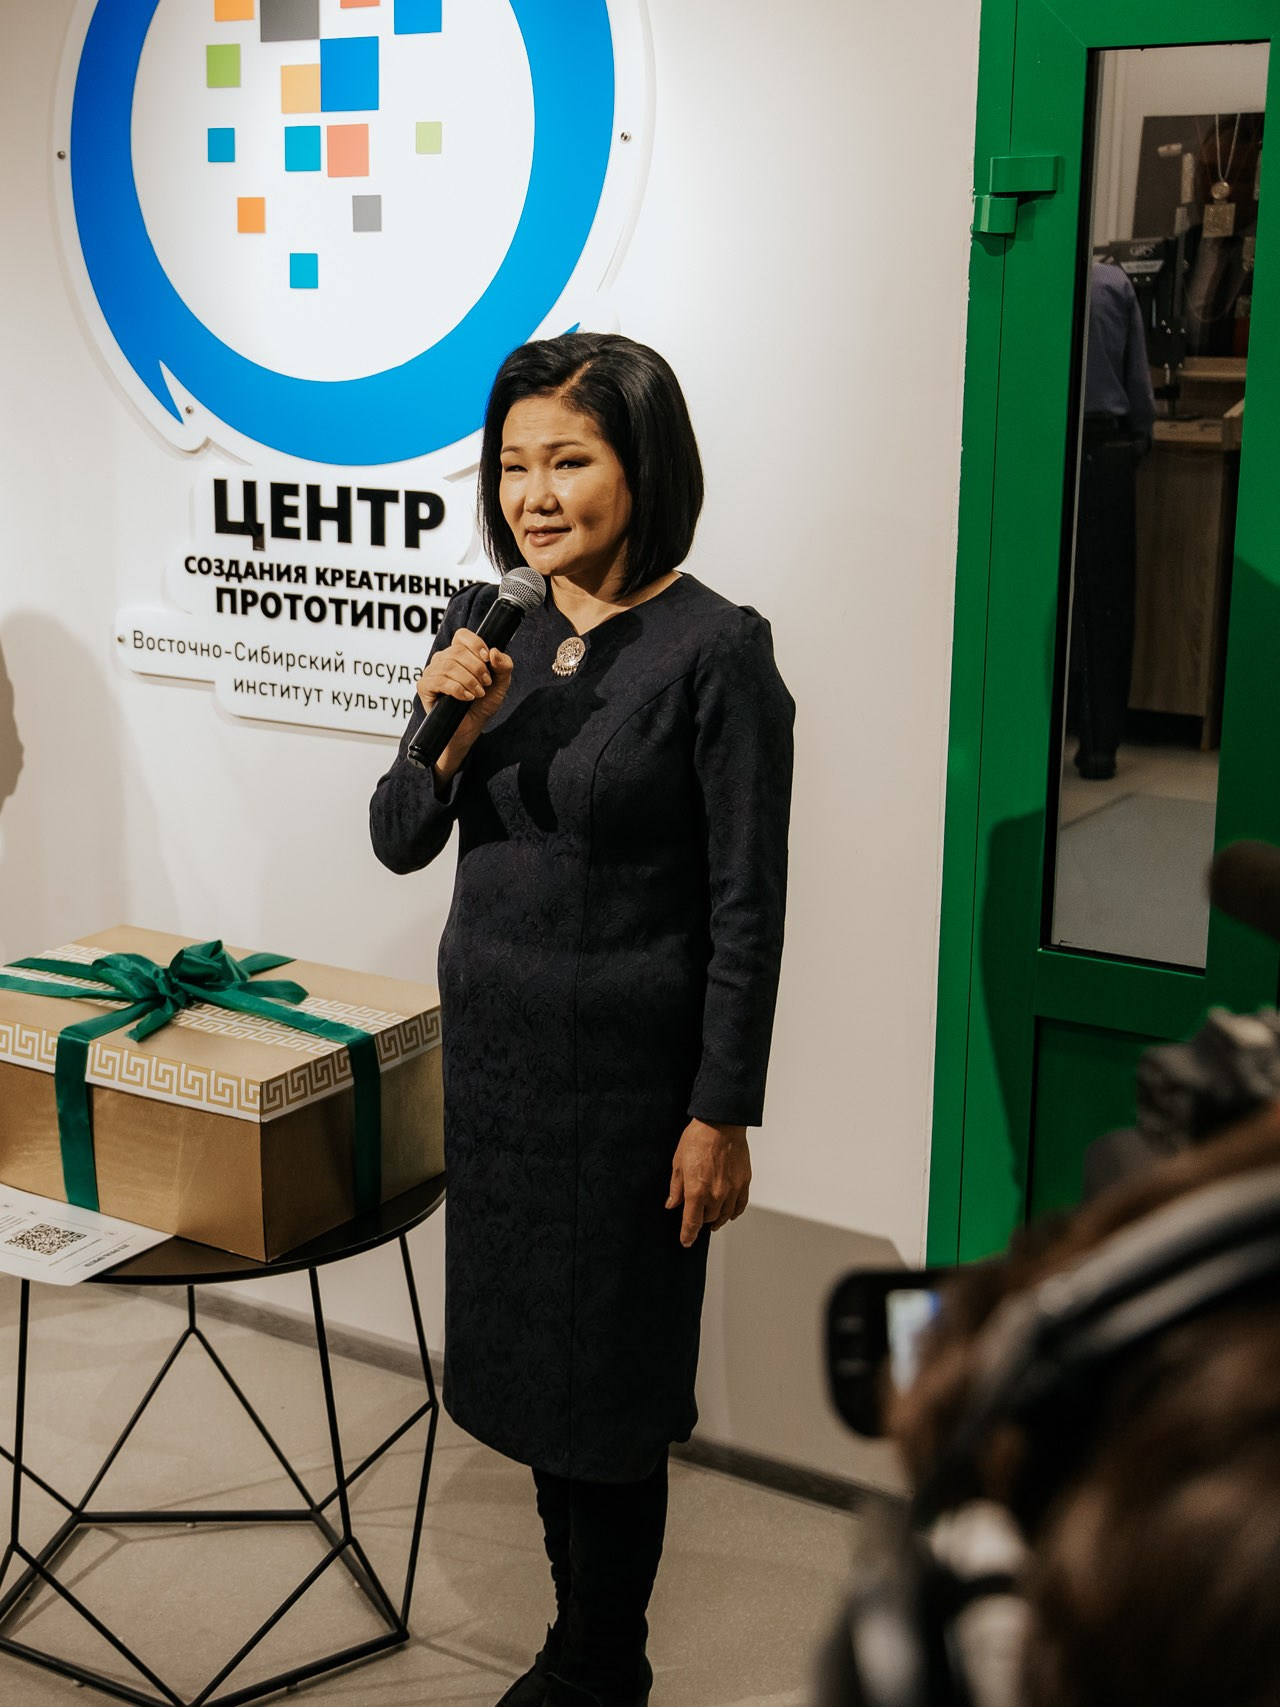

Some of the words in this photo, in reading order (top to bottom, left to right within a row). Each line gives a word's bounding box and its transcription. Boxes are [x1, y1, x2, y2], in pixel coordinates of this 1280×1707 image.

[213, 478, 445, 551] ЦЕНТР
[184, 556, 307, 584] СОЗДАНИЯ
[315, 567, 483, 598] КРЕАТИВНЫ
[133, 630, 345, 674] Восточно-Сибирский
[234, 678, 323, 706] институт
[332, 690, 413, 719] культур
